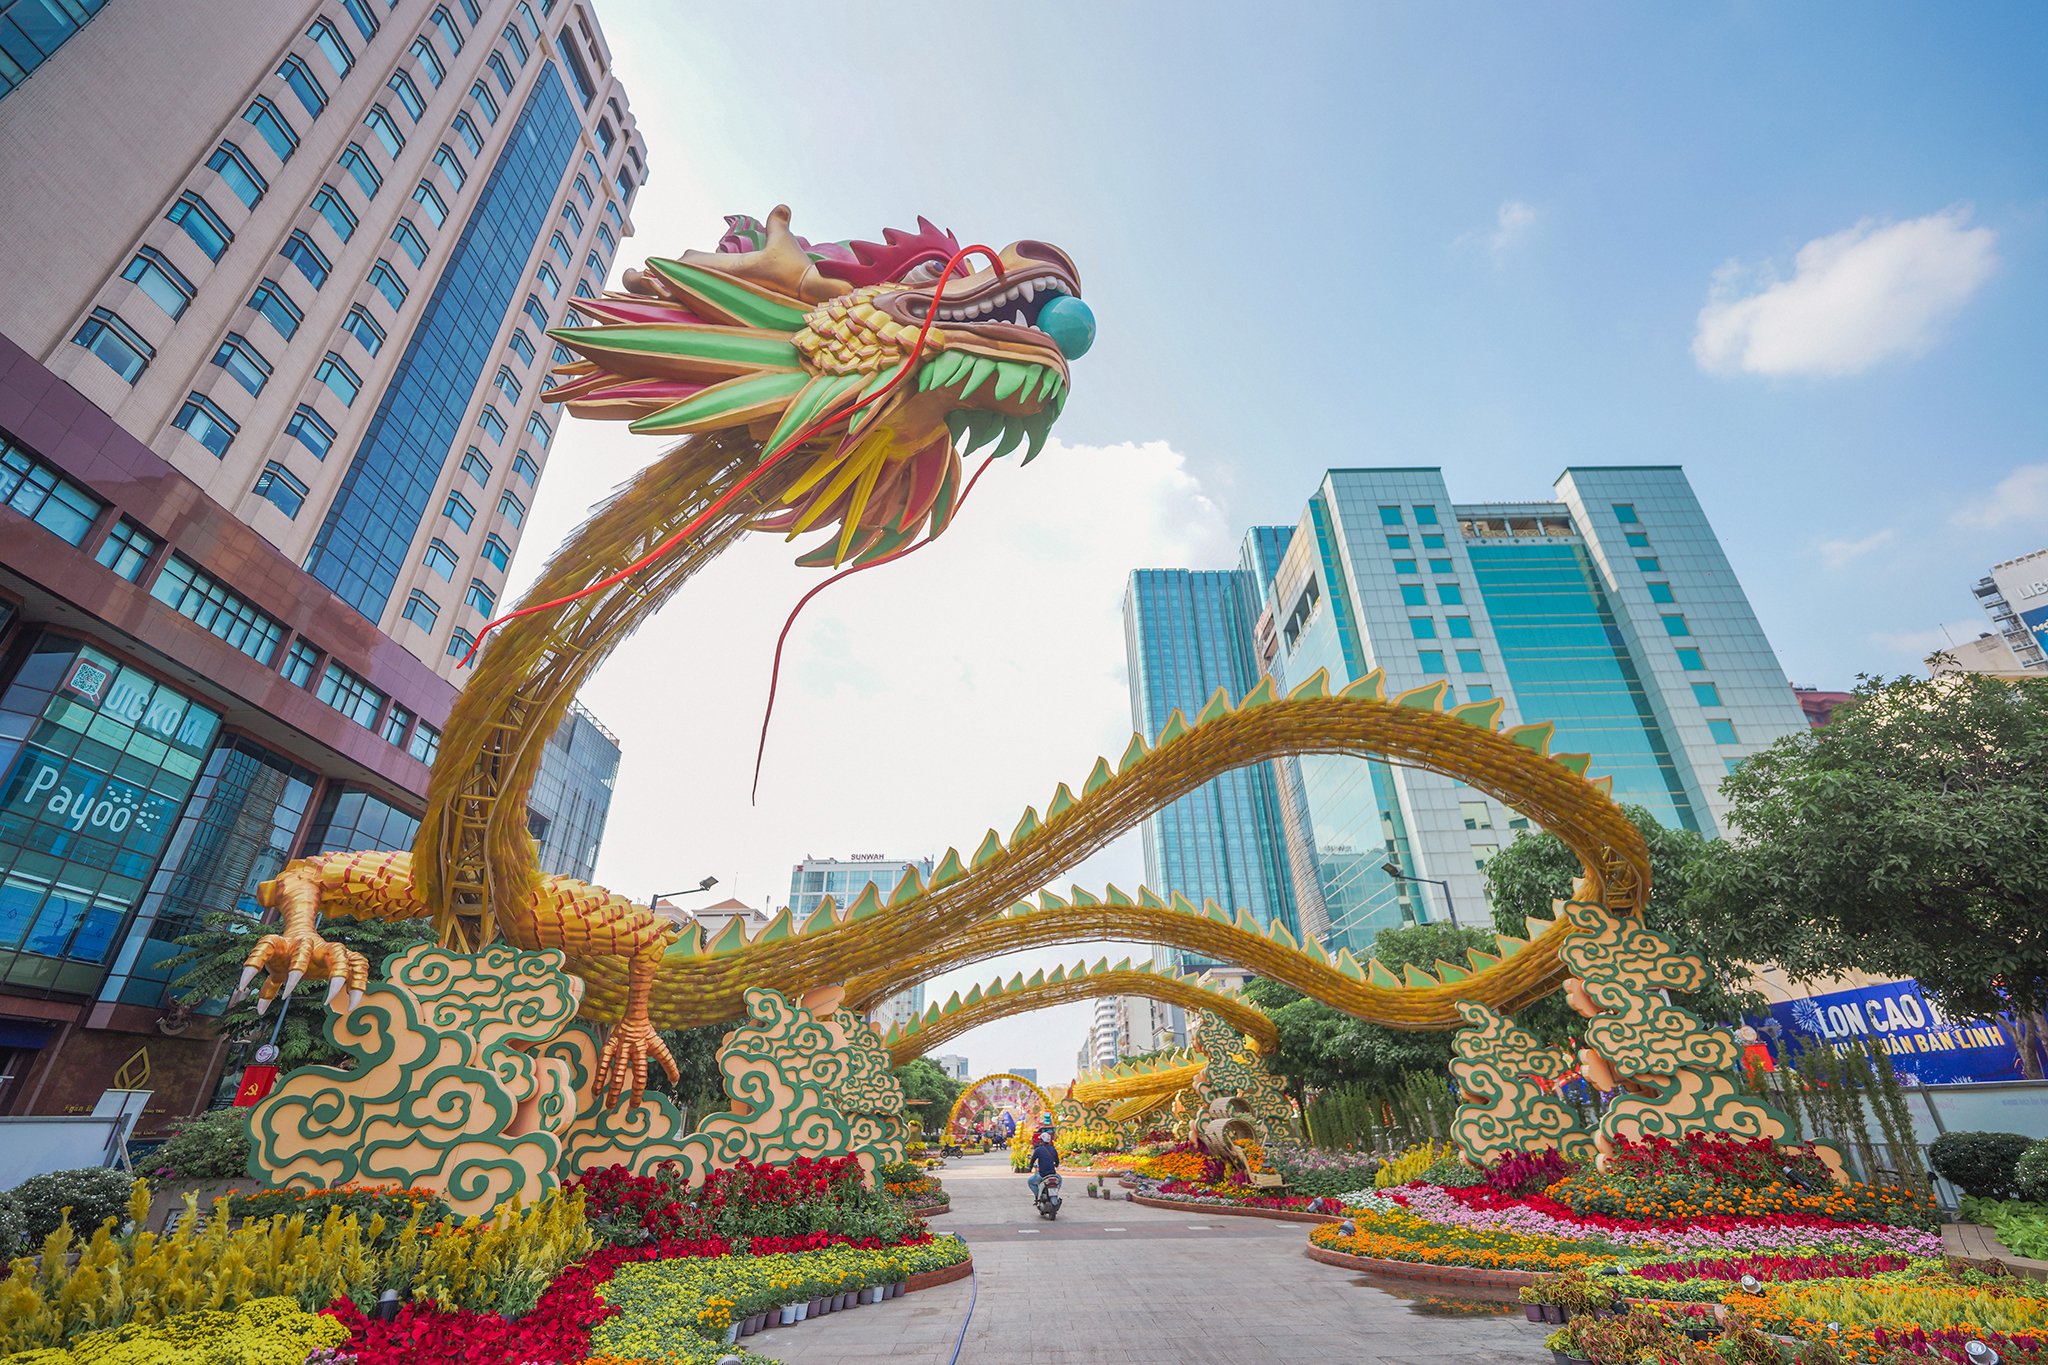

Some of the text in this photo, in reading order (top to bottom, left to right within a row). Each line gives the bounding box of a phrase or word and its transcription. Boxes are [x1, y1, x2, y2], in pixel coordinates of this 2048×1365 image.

[24, 765, 131, 832] Payoo
[1815, 1004, 1869, 1039] LON
[1865, 994, 1925, 1033] CAO
[1867, 1033, 1916, 1056] UÂN
[1914, 1026, 1956, 1052] BẢN
[1955, 1026, 2005, 1049] LINH
